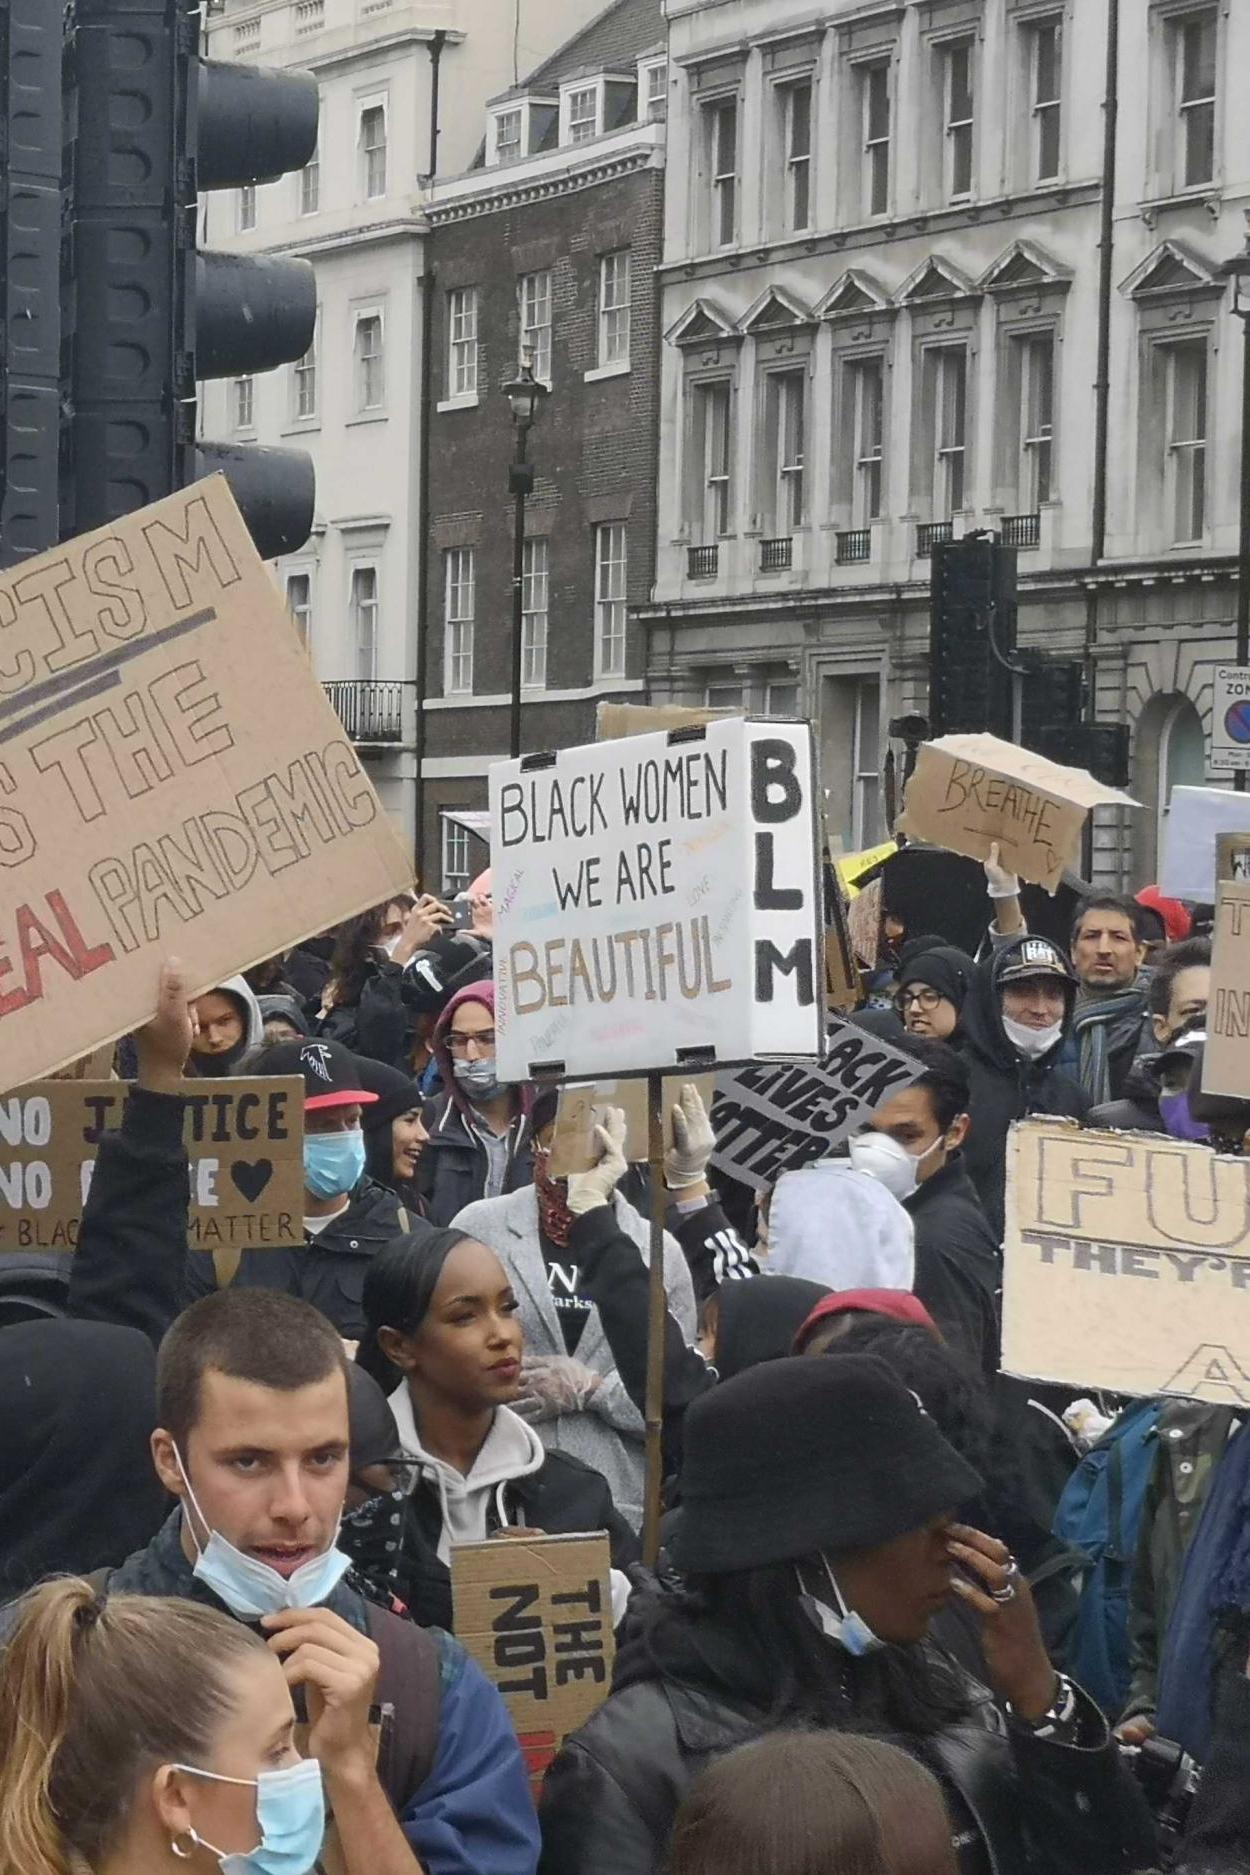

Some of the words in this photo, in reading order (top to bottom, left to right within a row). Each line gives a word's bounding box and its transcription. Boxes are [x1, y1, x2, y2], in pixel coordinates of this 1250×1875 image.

[30, 660, 234, 822] THE
[89, 740, 375, 954] PANDEMIC
[501, 773, 608, 847] BLACK
[620, 749, 727, 826] WOMEN
[938, 758, 1061, 847] BREATHE
[552, 857, 602, 911] WE
[616, 839, 675, 904] ARE
[509, 914, 733, 1016] BEAUTIFUL
[82, 1091, 288, 1144] JTICE
[17, 1218, 79, 1247] BLAC
[489, 1583, 548, 1700] NOT
[551, 1579, 606, 1686] THE
